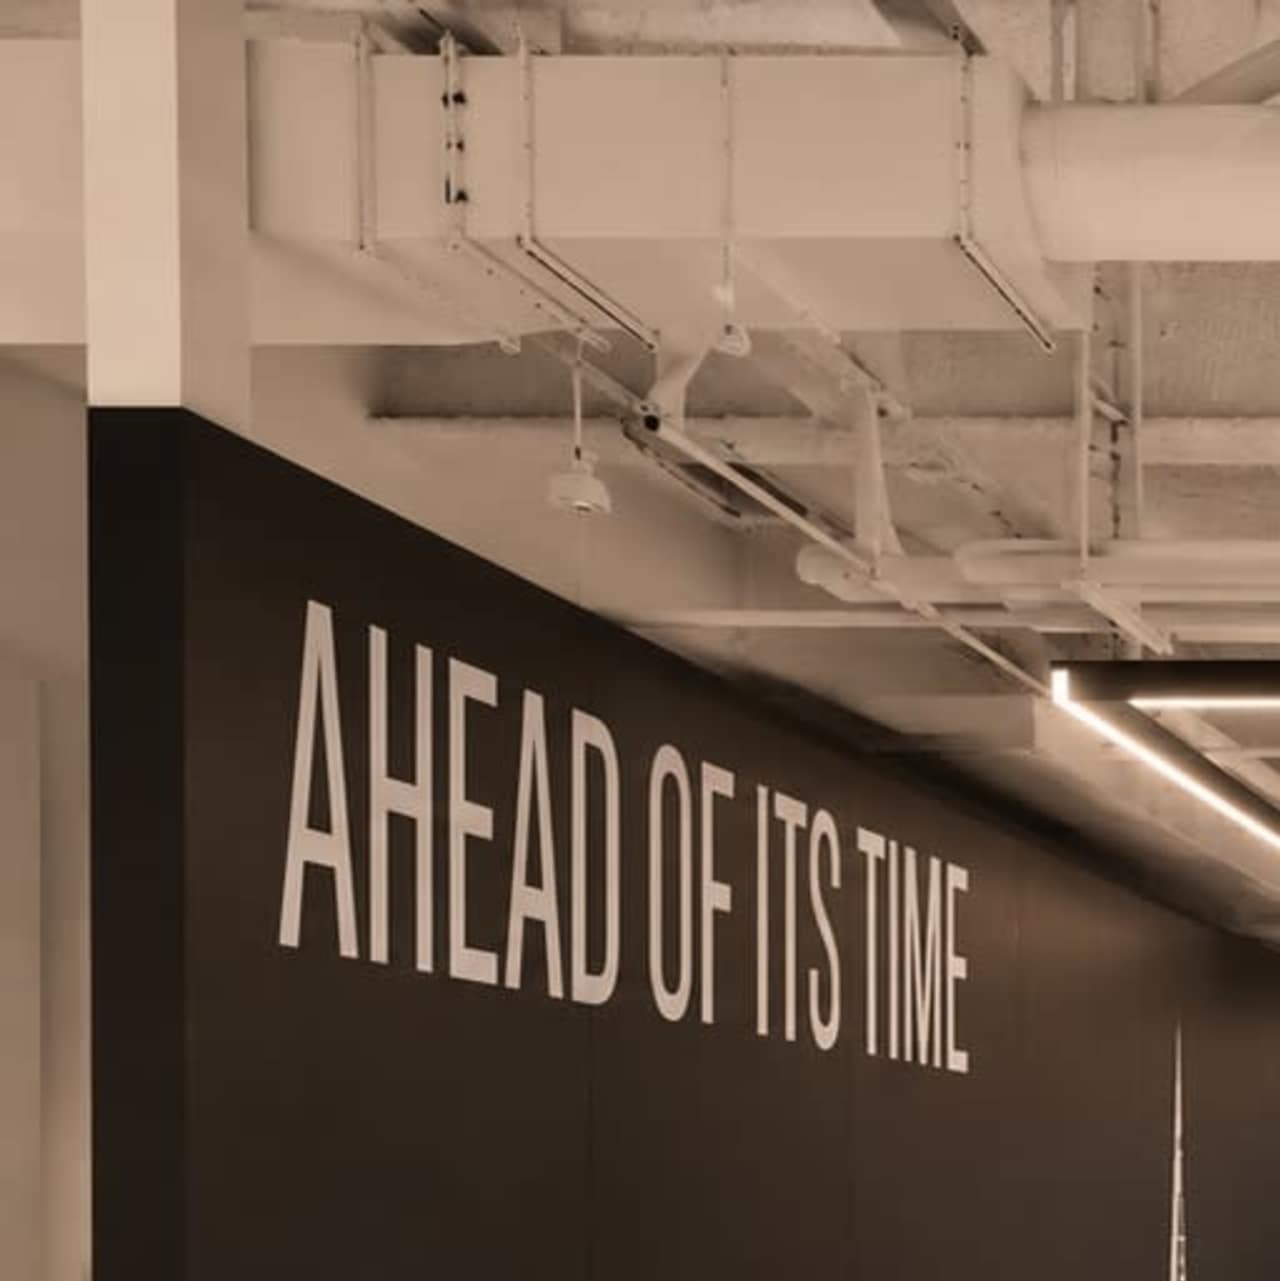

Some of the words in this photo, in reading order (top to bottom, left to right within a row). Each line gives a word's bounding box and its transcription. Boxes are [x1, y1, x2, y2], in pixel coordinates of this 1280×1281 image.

[279, 600, 620, 1004] AHEAD
[649, 744, 734, 1024] OF
[757, 785, 841, 1050] ITS
[857, 827, 968, 1073] TIME
